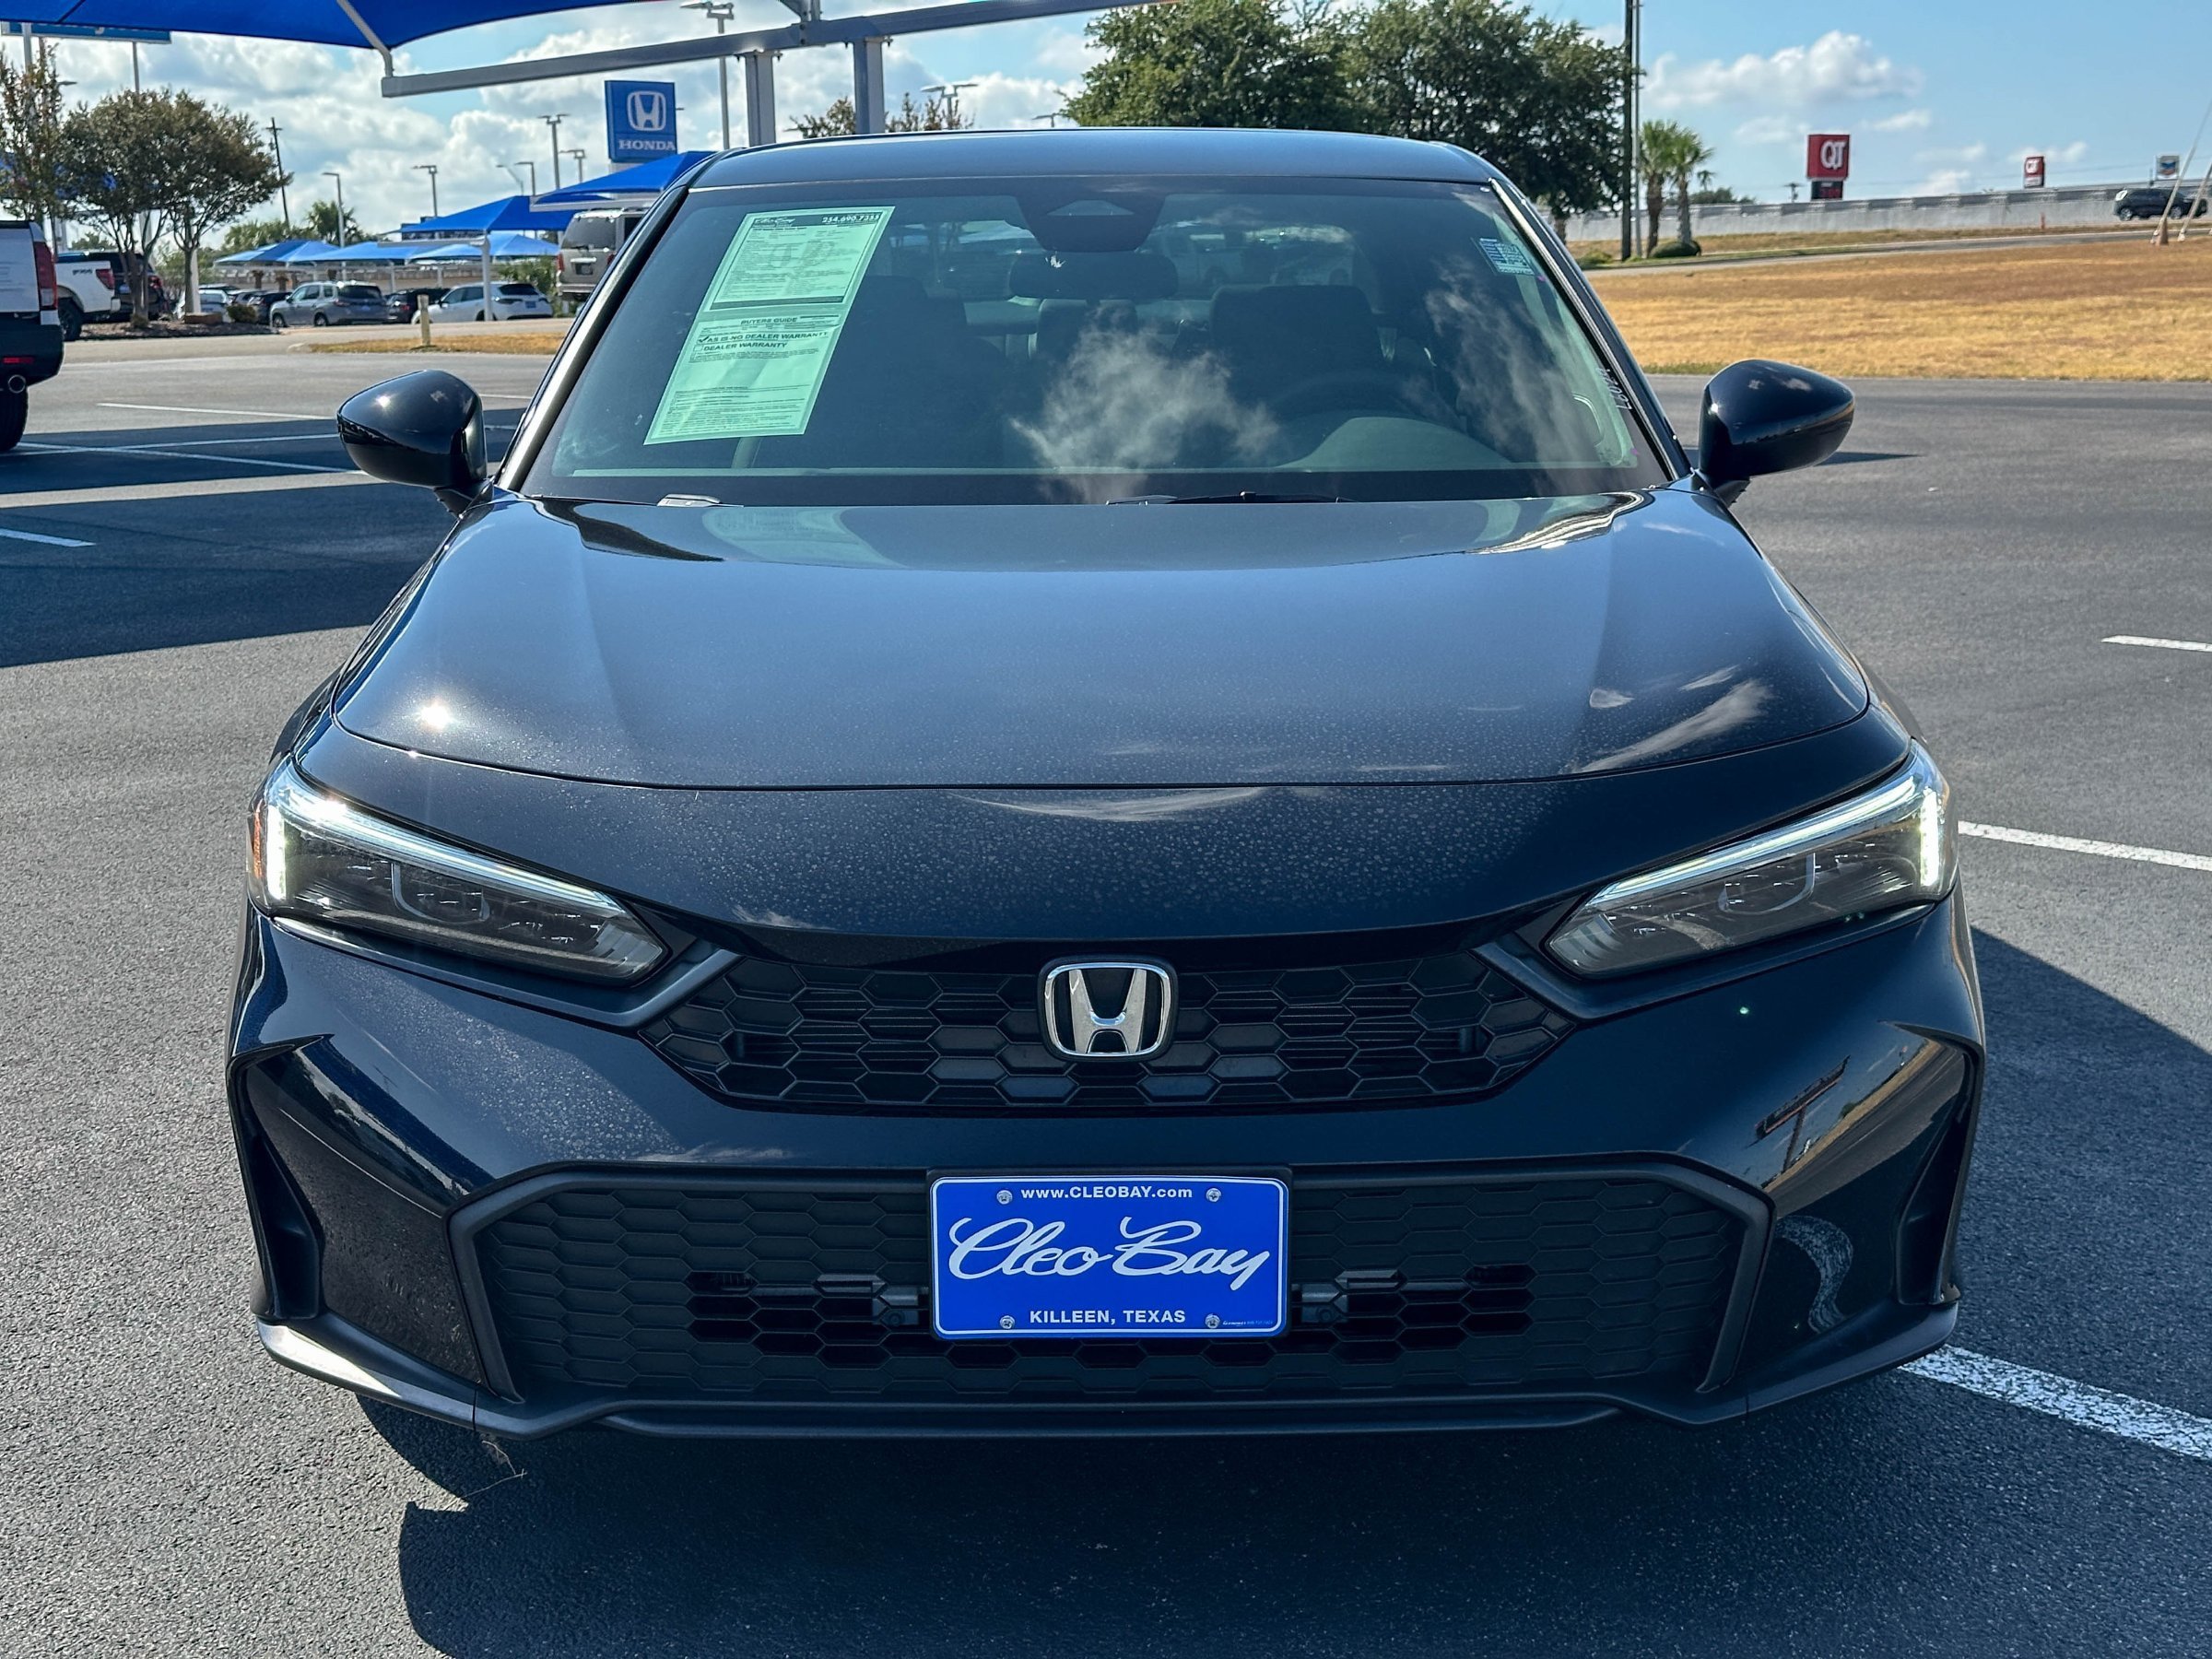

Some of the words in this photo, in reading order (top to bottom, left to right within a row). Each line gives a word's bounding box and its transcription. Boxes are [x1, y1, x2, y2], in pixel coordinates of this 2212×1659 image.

[618, 139, 676, 151] HONDA
[1820, 140, 1846, 170] QT
[703, 343, 737, 351] DEALER
[1022, 1185, 1193, 1199] www.CLEOBAY.com
[948, 1217, 1112, 1280] Cleo
[1112, 1215, 1271, 1291] Bay
[1030, 1310, 1116, 1324] KILLEEN,
[1123, 1310, 1186, 1324] TEXAS
